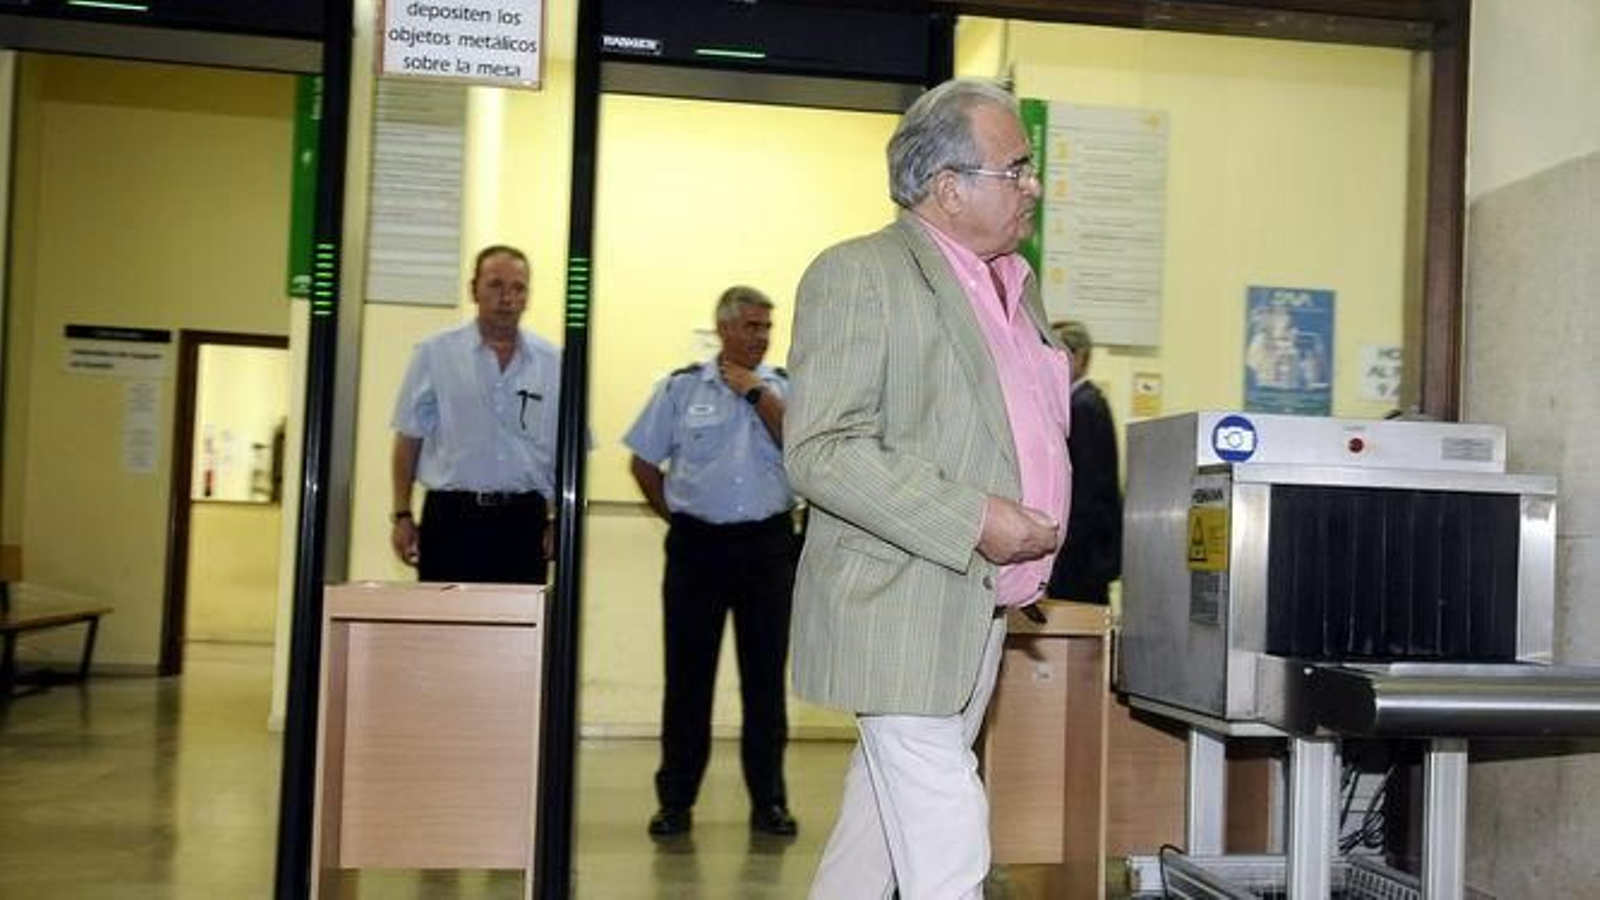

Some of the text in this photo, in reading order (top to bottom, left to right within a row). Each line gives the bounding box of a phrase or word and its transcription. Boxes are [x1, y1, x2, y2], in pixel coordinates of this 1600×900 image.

[406, 3, 522, 26] depositen los
[388, 26, 451, 48] objetos
[403, 55, 521, 77] sobre la mesa
